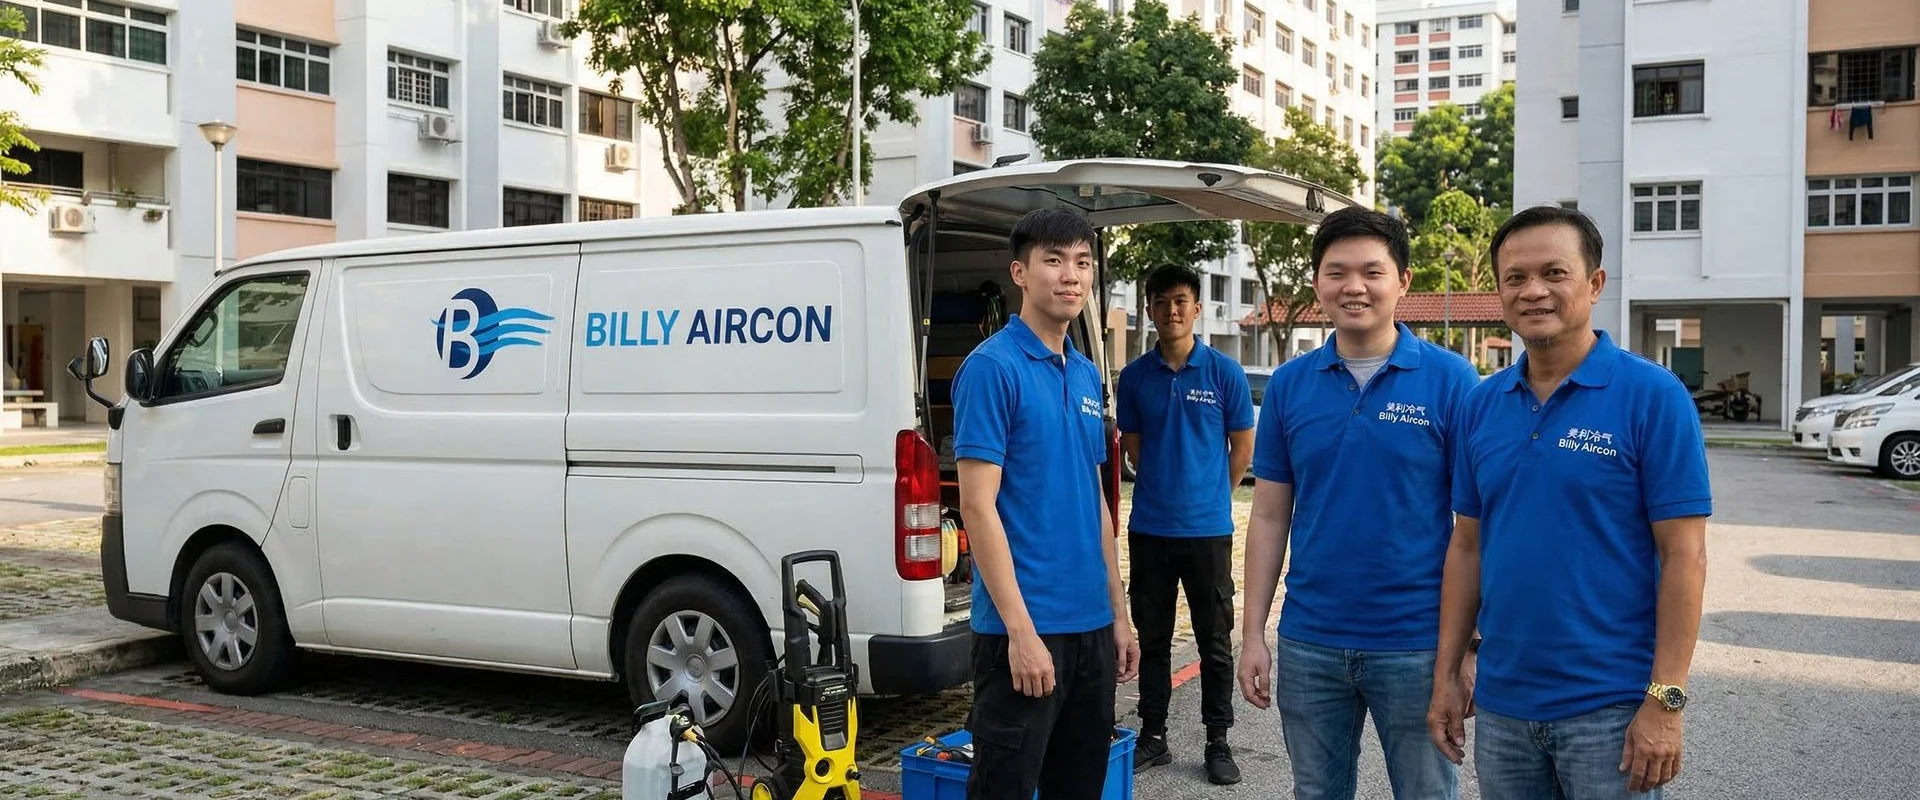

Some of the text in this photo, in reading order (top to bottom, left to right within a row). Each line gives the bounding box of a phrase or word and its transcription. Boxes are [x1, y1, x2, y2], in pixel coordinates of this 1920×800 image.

[585, 305, 832, 347] BILLY AIRCON
[1379, 411, 1430, 426] Billy Aircon
[1558, 438, 1617, 457] Billy Aircon
